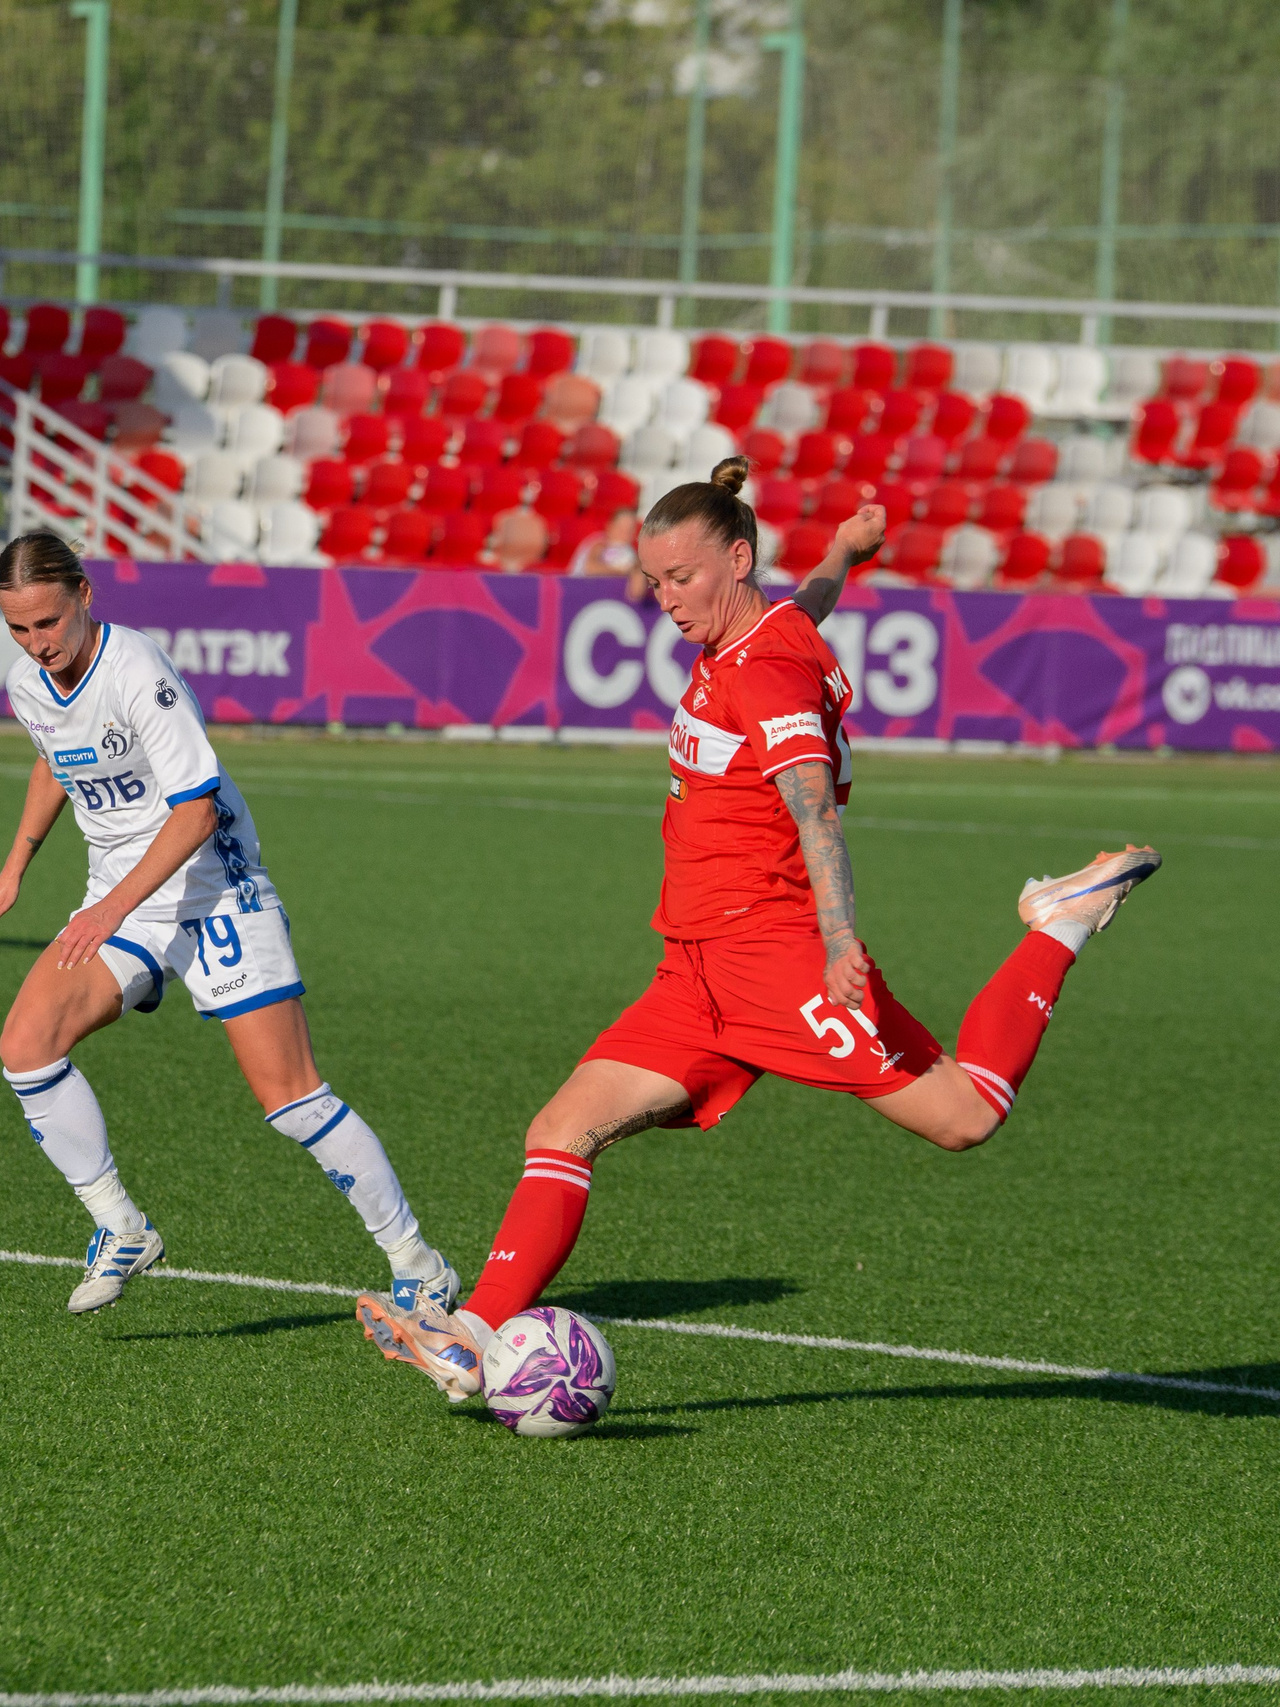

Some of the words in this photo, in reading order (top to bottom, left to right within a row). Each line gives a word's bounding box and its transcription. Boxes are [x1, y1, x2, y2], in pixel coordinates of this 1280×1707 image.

[770, 720, 798, 736] Альфа
[799, 717, 819, 728] Банк
[58, 752, 94, 763] БЕТСИТИ
[75, 770, 146, 810] ВТБ
[179, 914, 242, 977] 79
[211, 978, 245, 998] BOSCO
